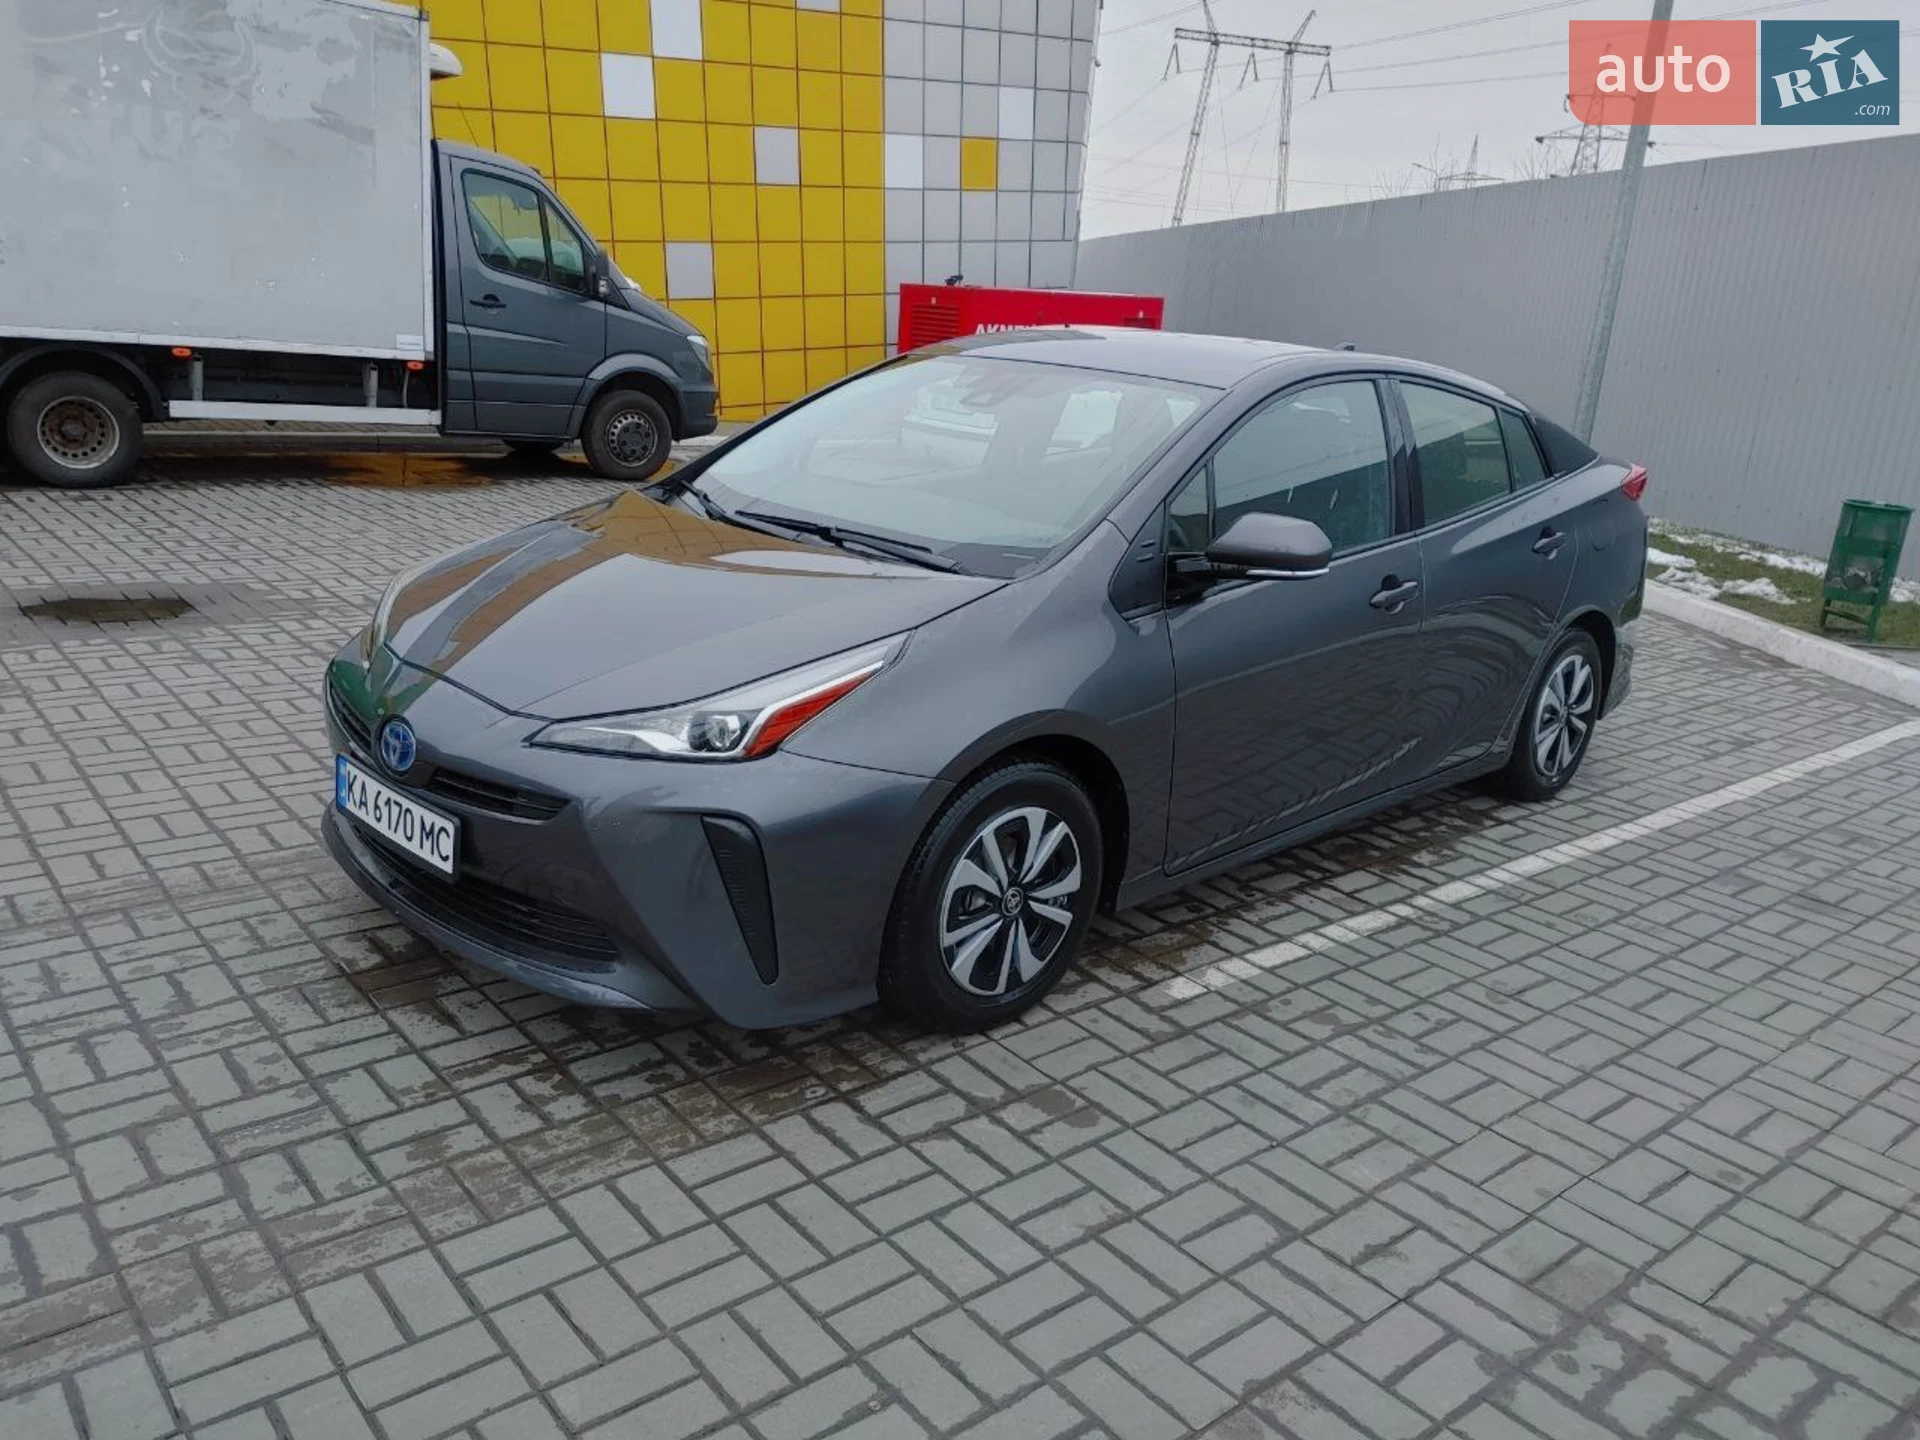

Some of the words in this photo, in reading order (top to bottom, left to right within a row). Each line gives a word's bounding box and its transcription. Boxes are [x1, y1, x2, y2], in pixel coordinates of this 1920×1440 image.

[347, 770, 370, 816] KA
[373, 790, 415, 843] 6170
[419, 815, 451, 863] MC
